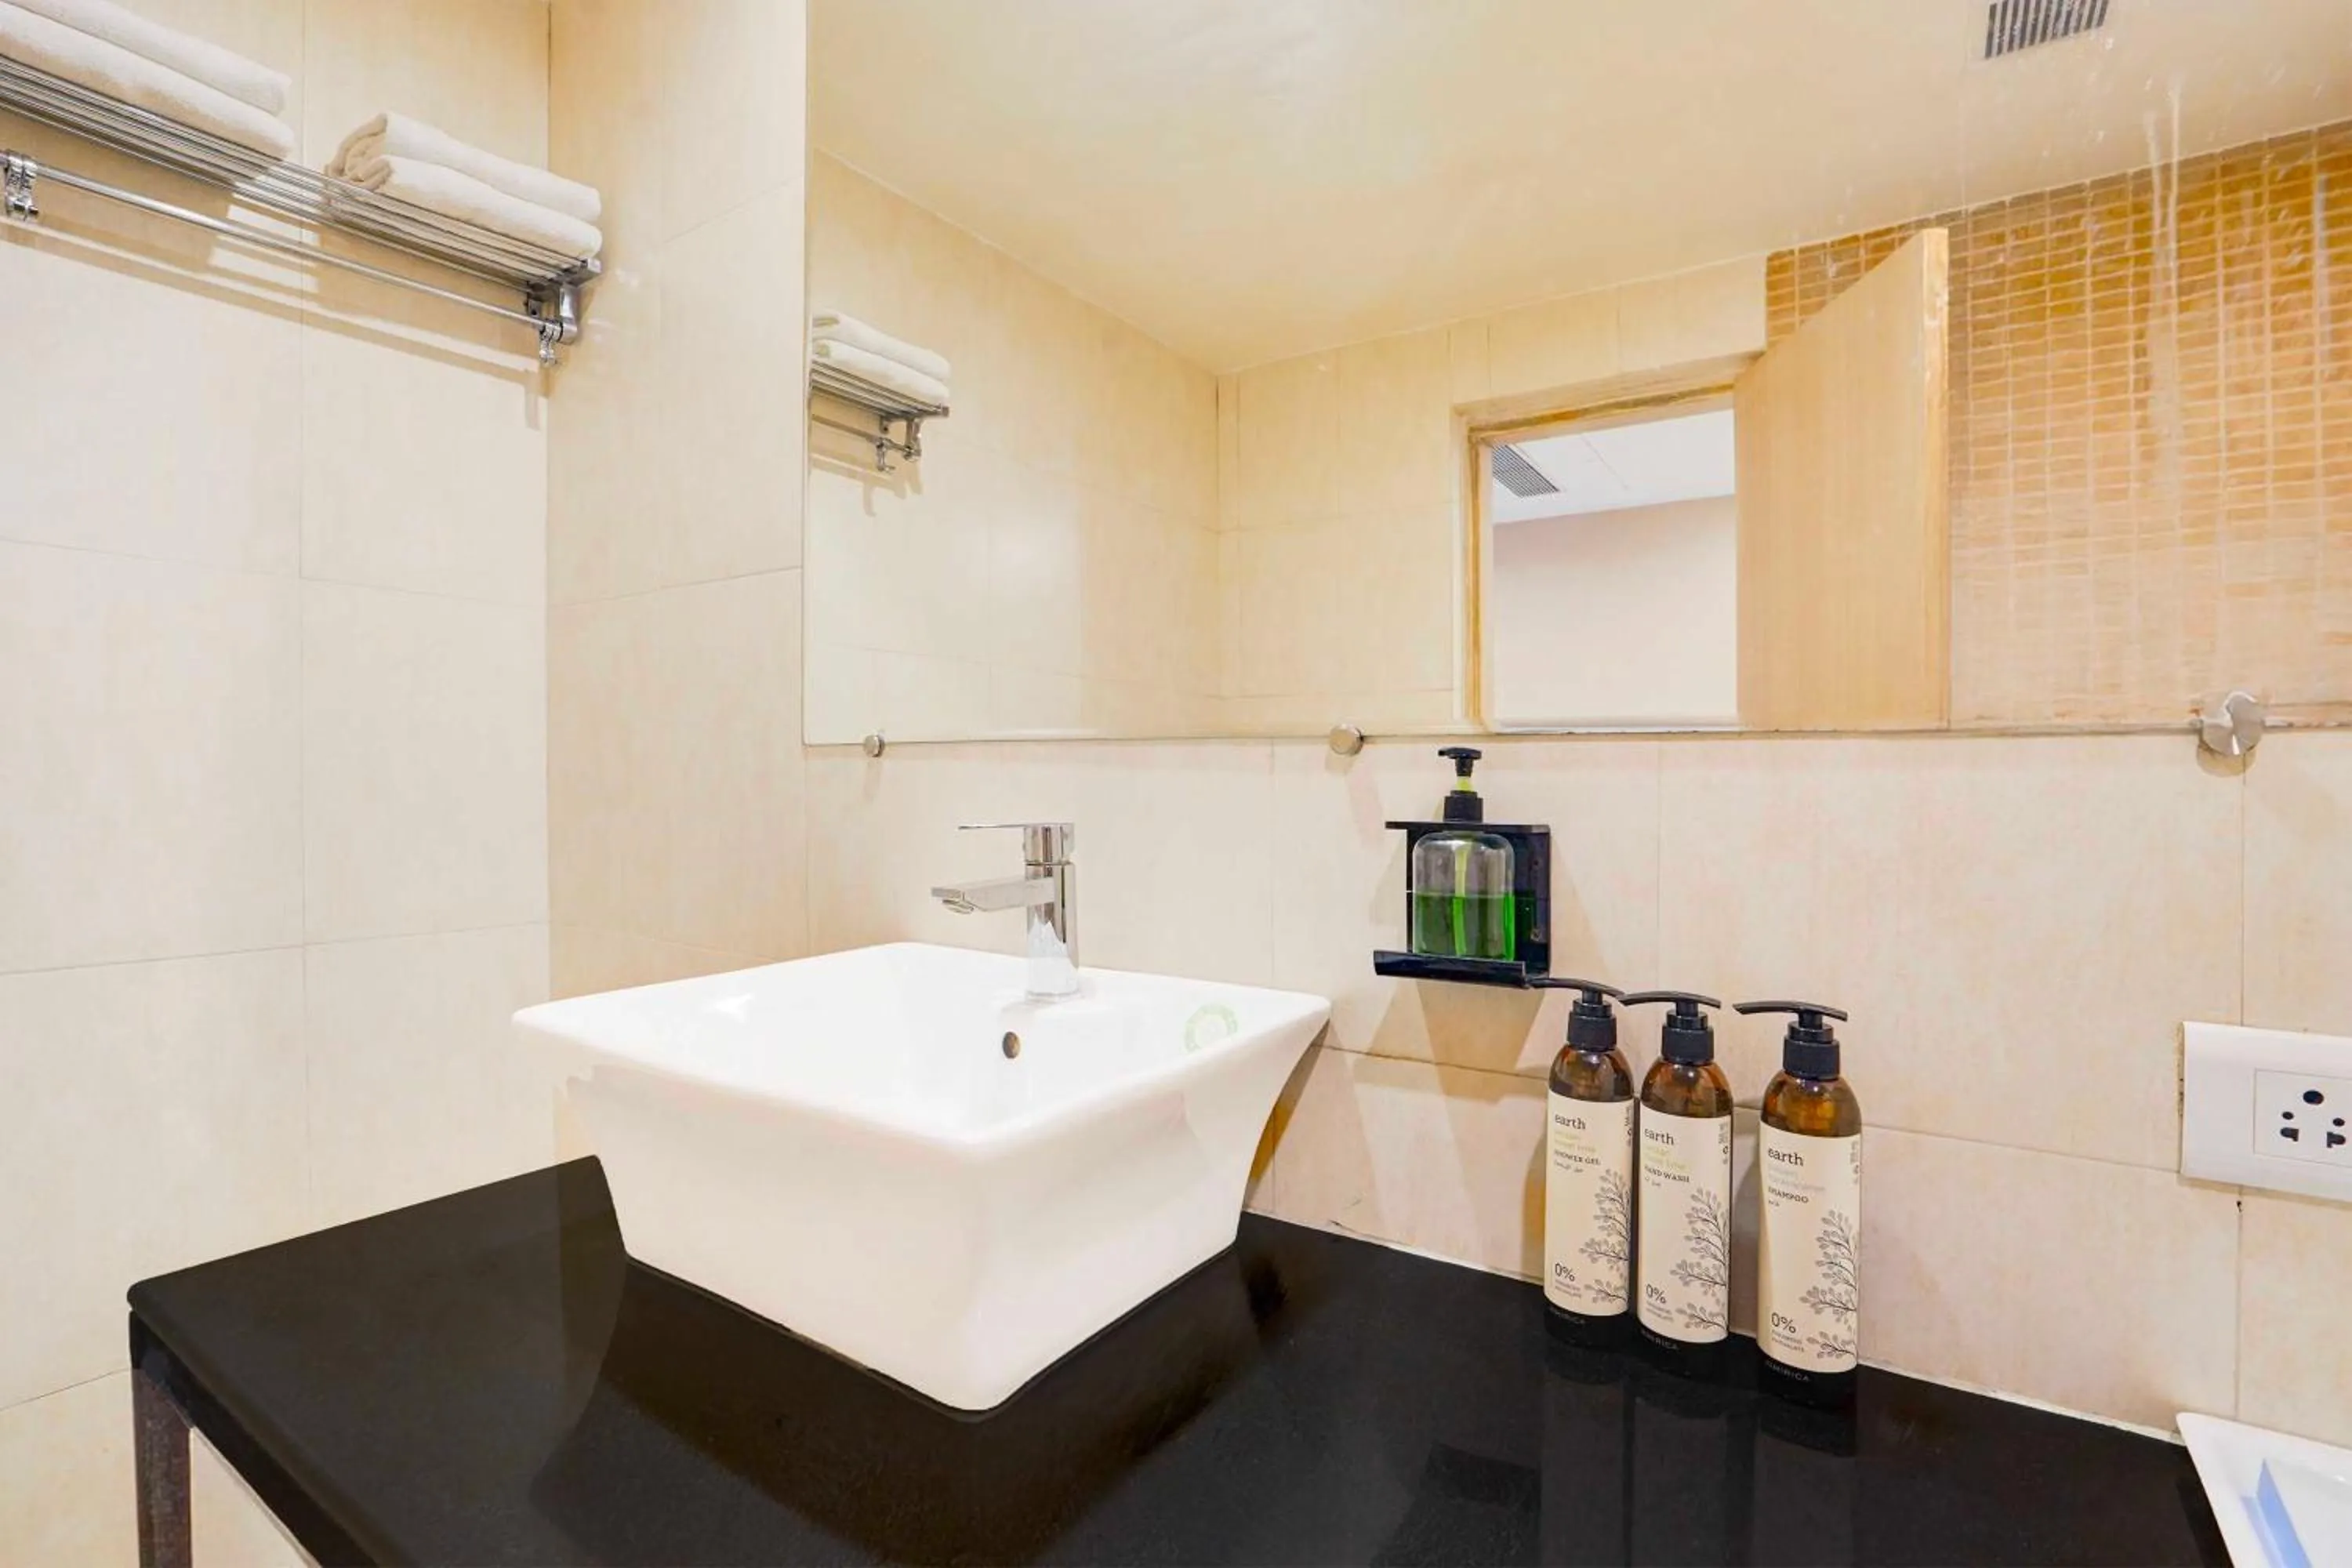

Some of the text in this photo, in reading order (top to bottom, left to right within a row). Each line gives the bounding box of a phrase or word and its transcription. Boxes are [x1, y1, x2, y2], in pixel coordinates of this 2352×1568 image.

[1555, 1114, 1586, 1130] earth
[1644, 1129, 1674, 1145] earth
[1768, 1148, 1804, 1167] earth
[1555, 1263, 1575, 1282] 0%
[1646, 1283, 1666, 1304] 0%
[1771, 1312, 1796, 1334] 0%
